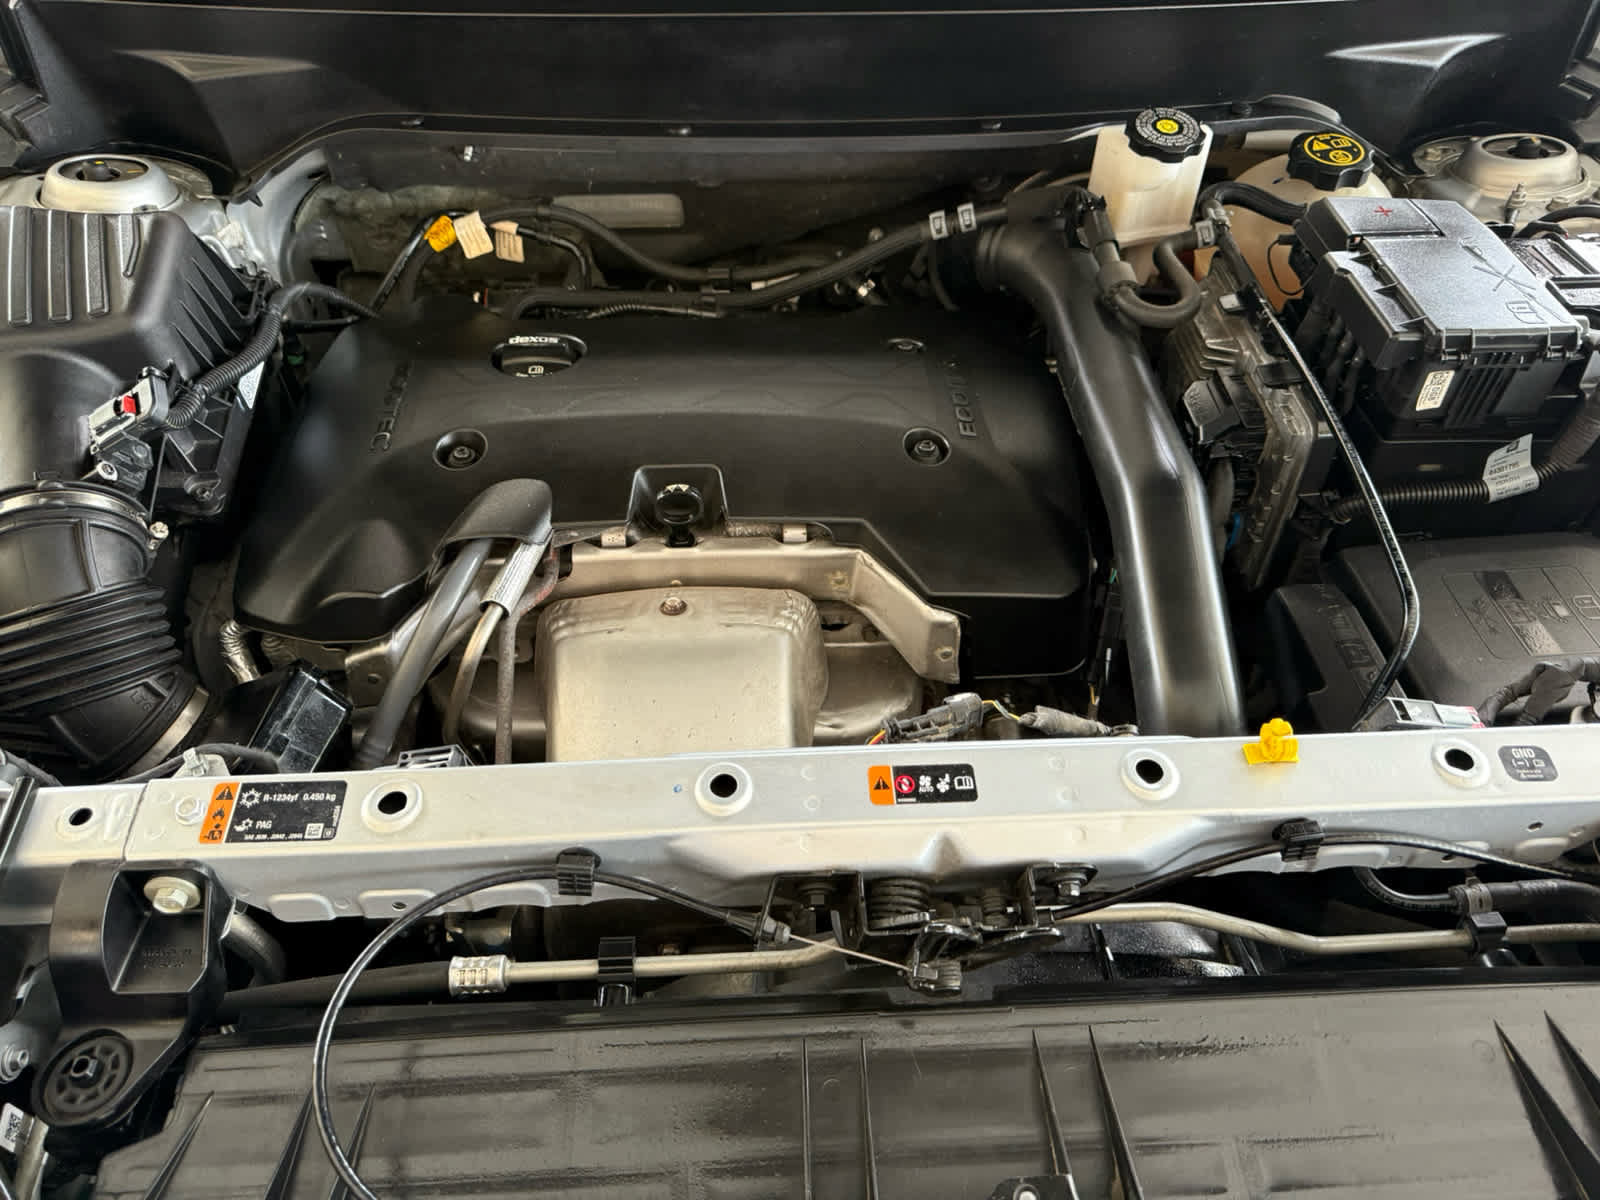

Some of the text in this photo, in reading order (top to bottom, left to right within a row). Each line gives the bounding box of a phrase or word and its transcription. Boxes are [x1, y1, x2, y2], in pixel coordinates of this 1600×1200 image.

[508, 335, 559, 345] dexos
[1511, 747, 1536, 759] GND
[262, 792, 337, 803] R-1234yf 0.450 kg
[255, 820, 273, 829] PAG
